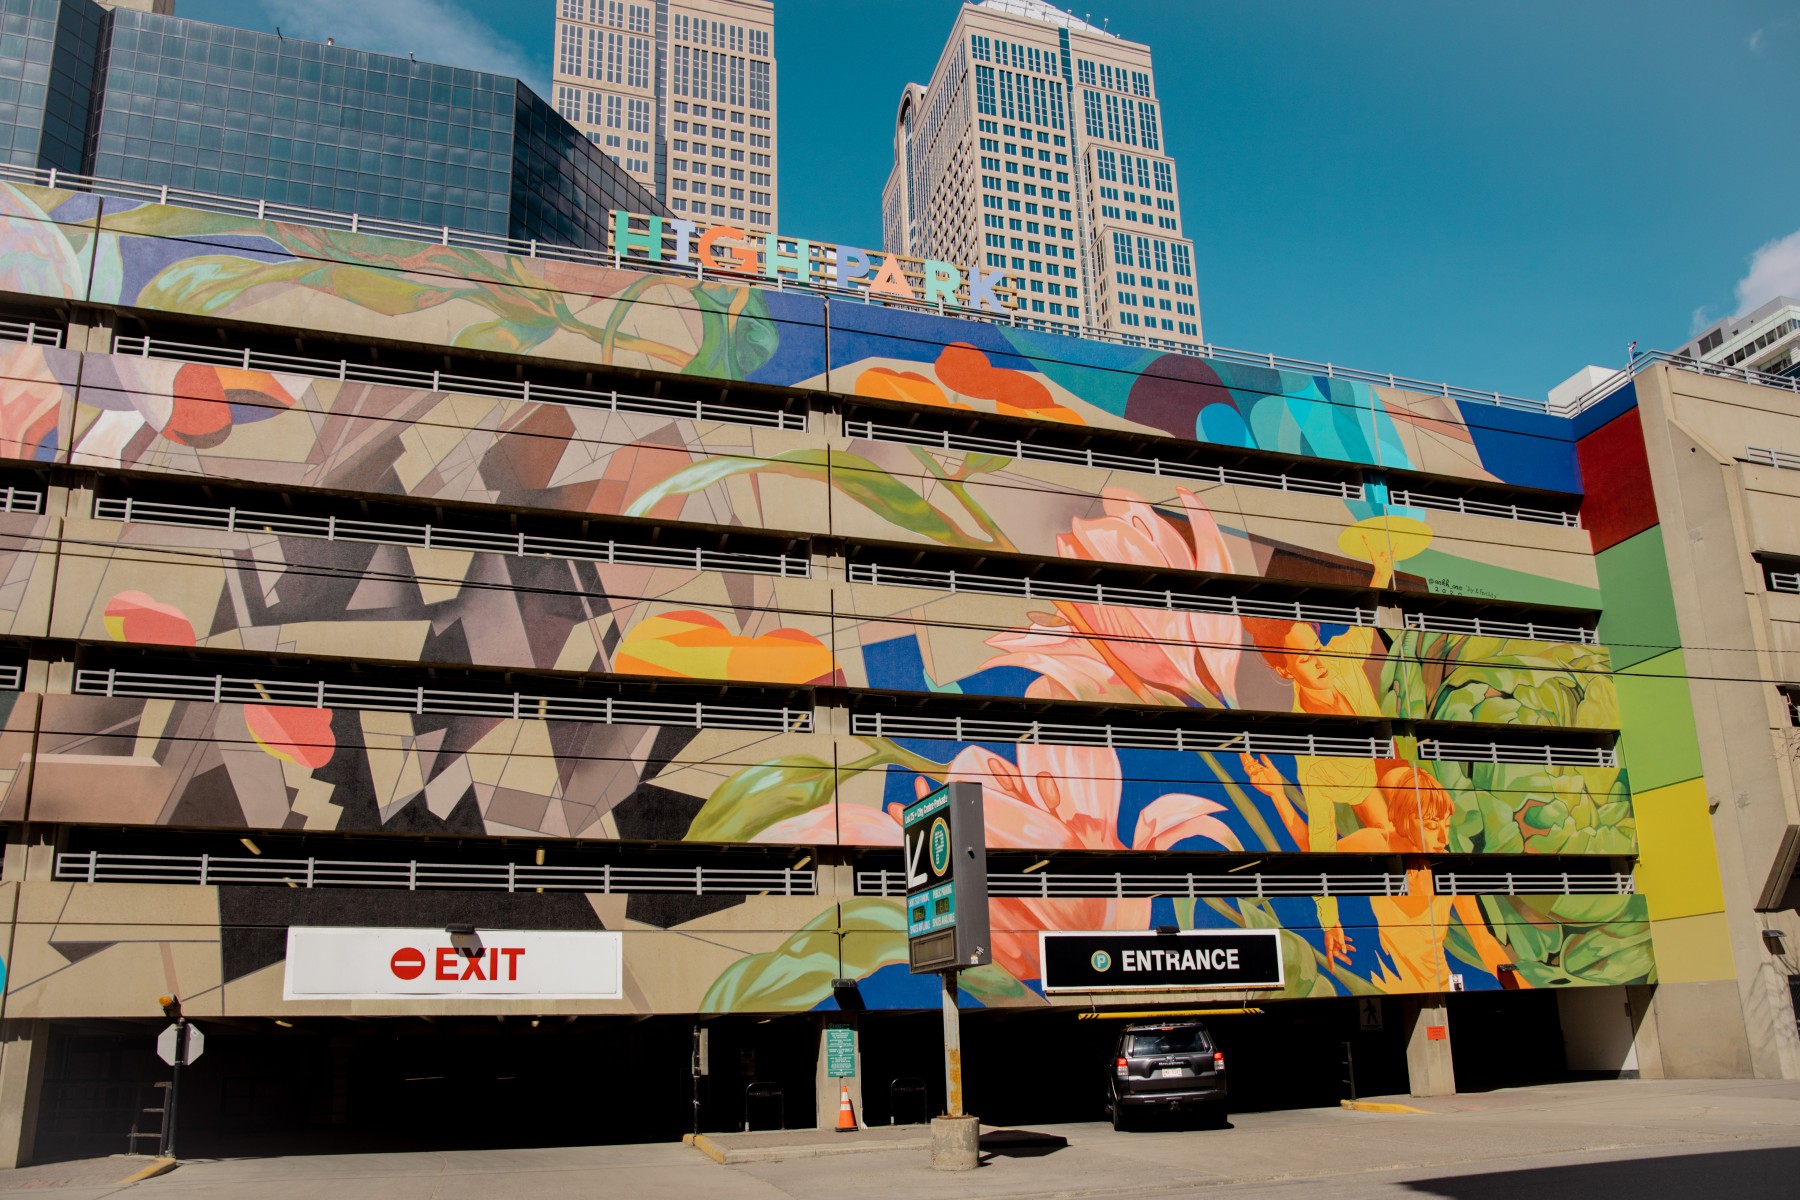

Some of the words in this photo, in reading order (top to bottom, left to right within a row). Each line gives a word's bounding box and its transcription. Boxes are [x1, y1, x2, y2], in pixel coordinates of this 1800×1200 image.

[615, 210, 809, 283] HIGH
[836, 244, 1005, 314] PARK
[435, 947, 525, 980] EXIT
[1122, 949, 1240, 971] ENTRANCE
